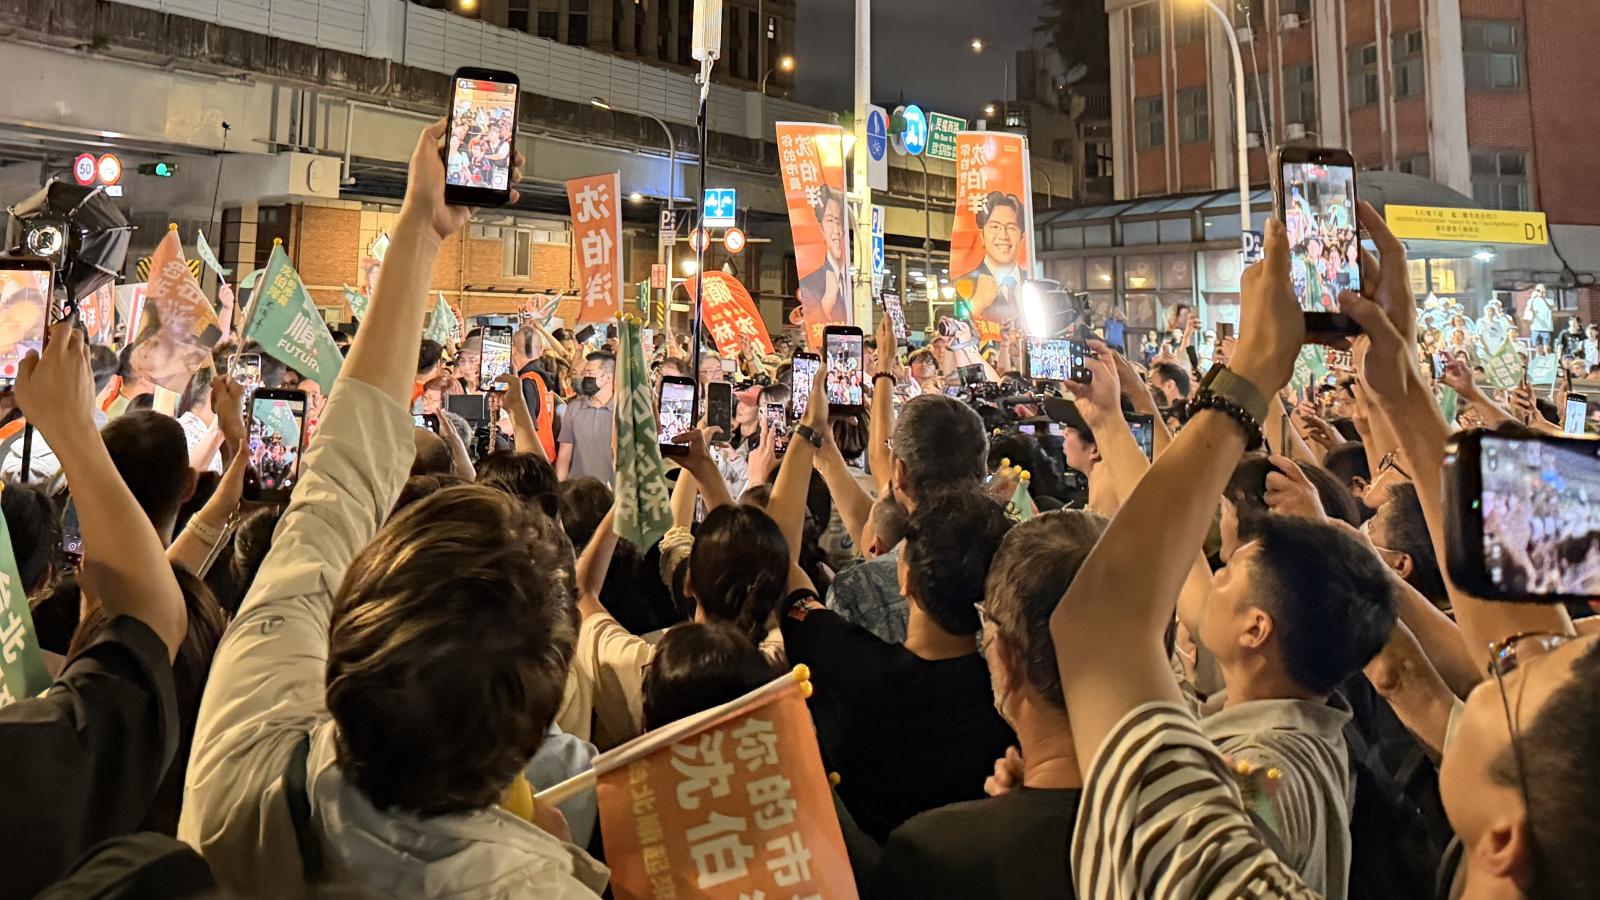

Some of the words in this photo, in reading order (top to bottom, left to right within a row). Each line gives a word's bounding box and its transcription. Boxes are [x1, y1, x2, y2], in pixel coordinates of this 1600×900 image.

[80, 163, 92, 175] 50
[662, 210, 671, 230] P
[1524, 223, 1544, 241] D1
[1243, 232, 1255, 262] P
[670, 730, 766, 900] 沈伯
[732, 718, 824, 900] 你的市
